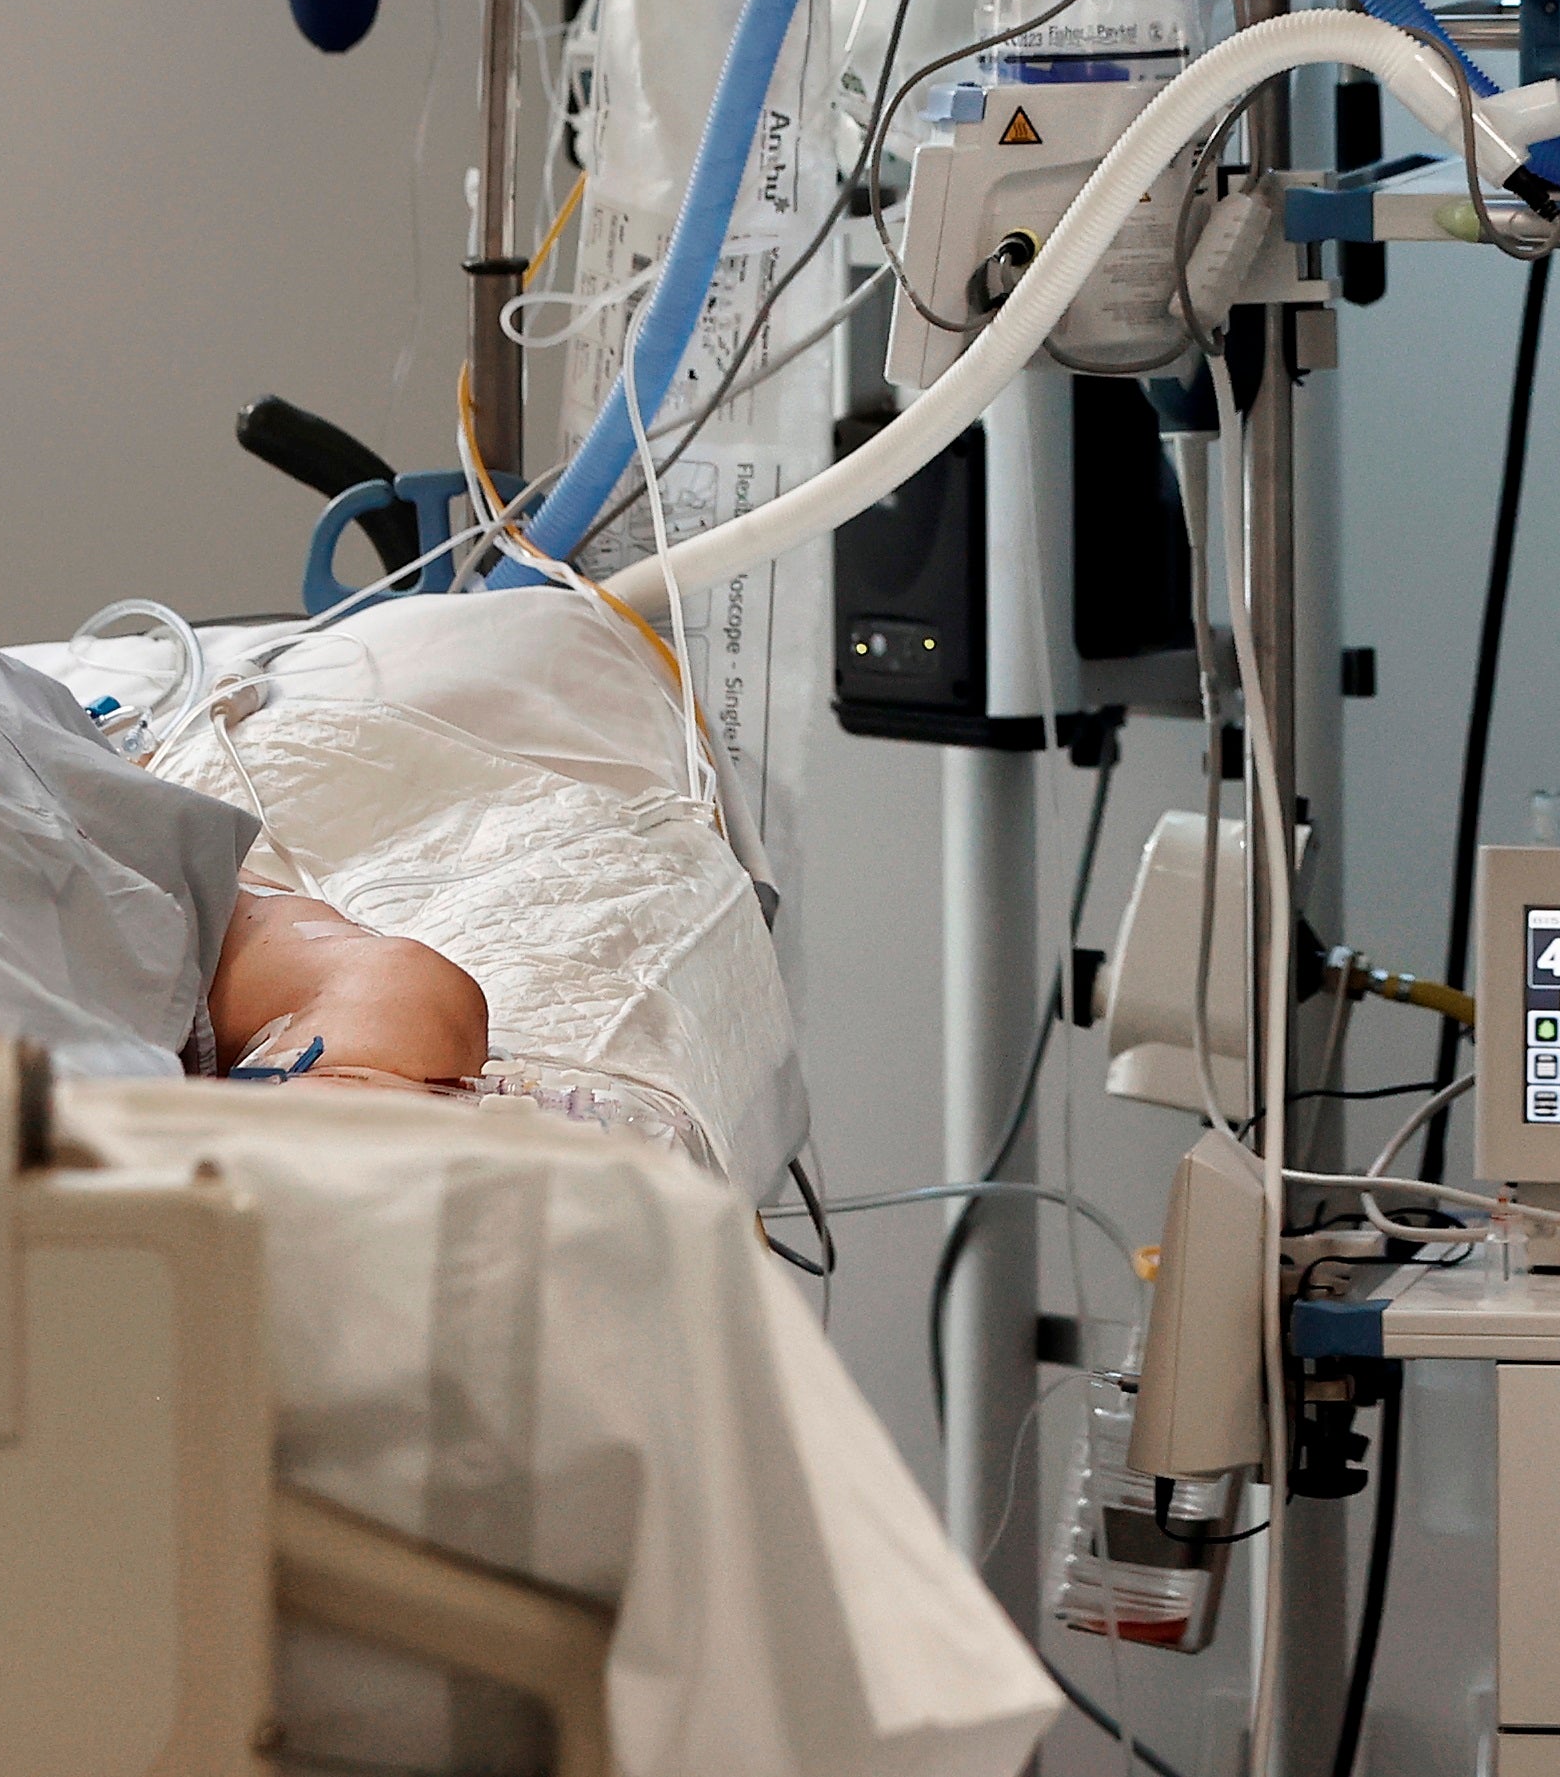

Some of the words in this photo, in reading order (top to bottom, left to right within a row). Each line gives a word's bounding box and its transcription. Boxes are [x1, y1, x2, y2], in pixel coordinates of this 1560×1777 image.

[735, 462, 754, 518] Flexib
[723, 574, 748, 655] oscope
[719, 677, 743, 745] Single
